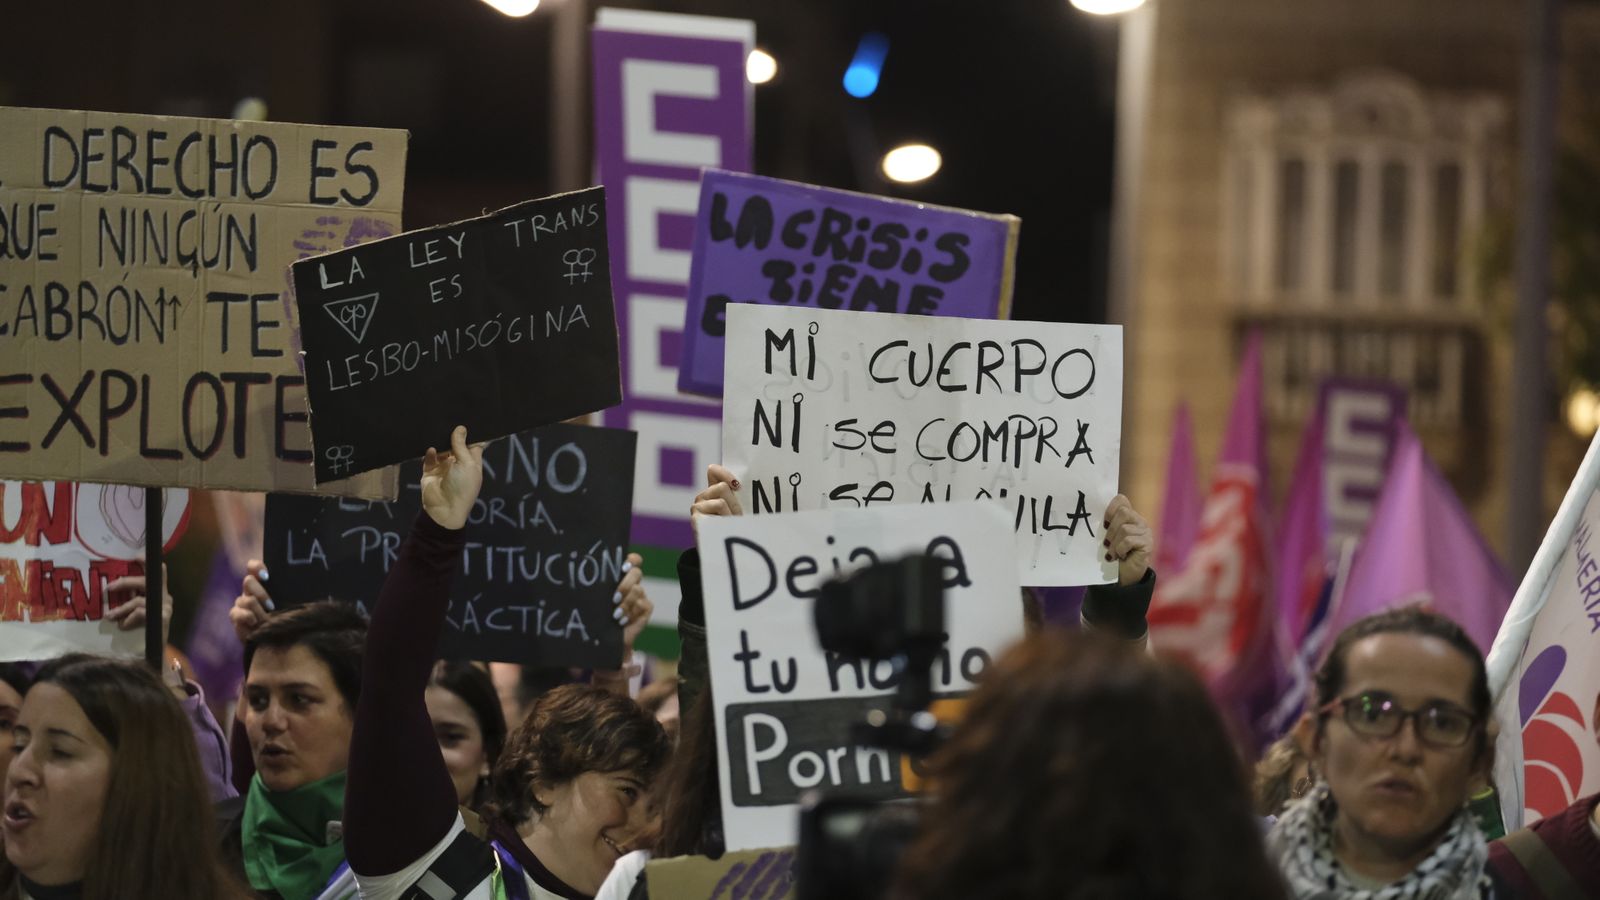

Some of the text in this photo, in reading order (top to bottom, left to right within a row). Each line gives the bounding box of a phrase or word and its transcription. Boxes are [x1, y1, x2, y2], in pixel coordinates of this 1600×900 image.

[43, 126, 379, 206] DERECHO ES
[99, 202, 257, 277] NINGÚN
[319, 203, 600, 290] LA LEY TRANS
[710, 192, 774, 251] LA
[429, 274, 463, 303] ES
[206, 292, 283, 357] TE
[326, 304, 590, 391] LESBO-MISÓGINA
[868, 338, 1096, 399] CUERPO
[916, 414, 1096, 468] COMPRA
[287, 528, 328, 570] LA
[734, 629, 994, 694] tu noio
